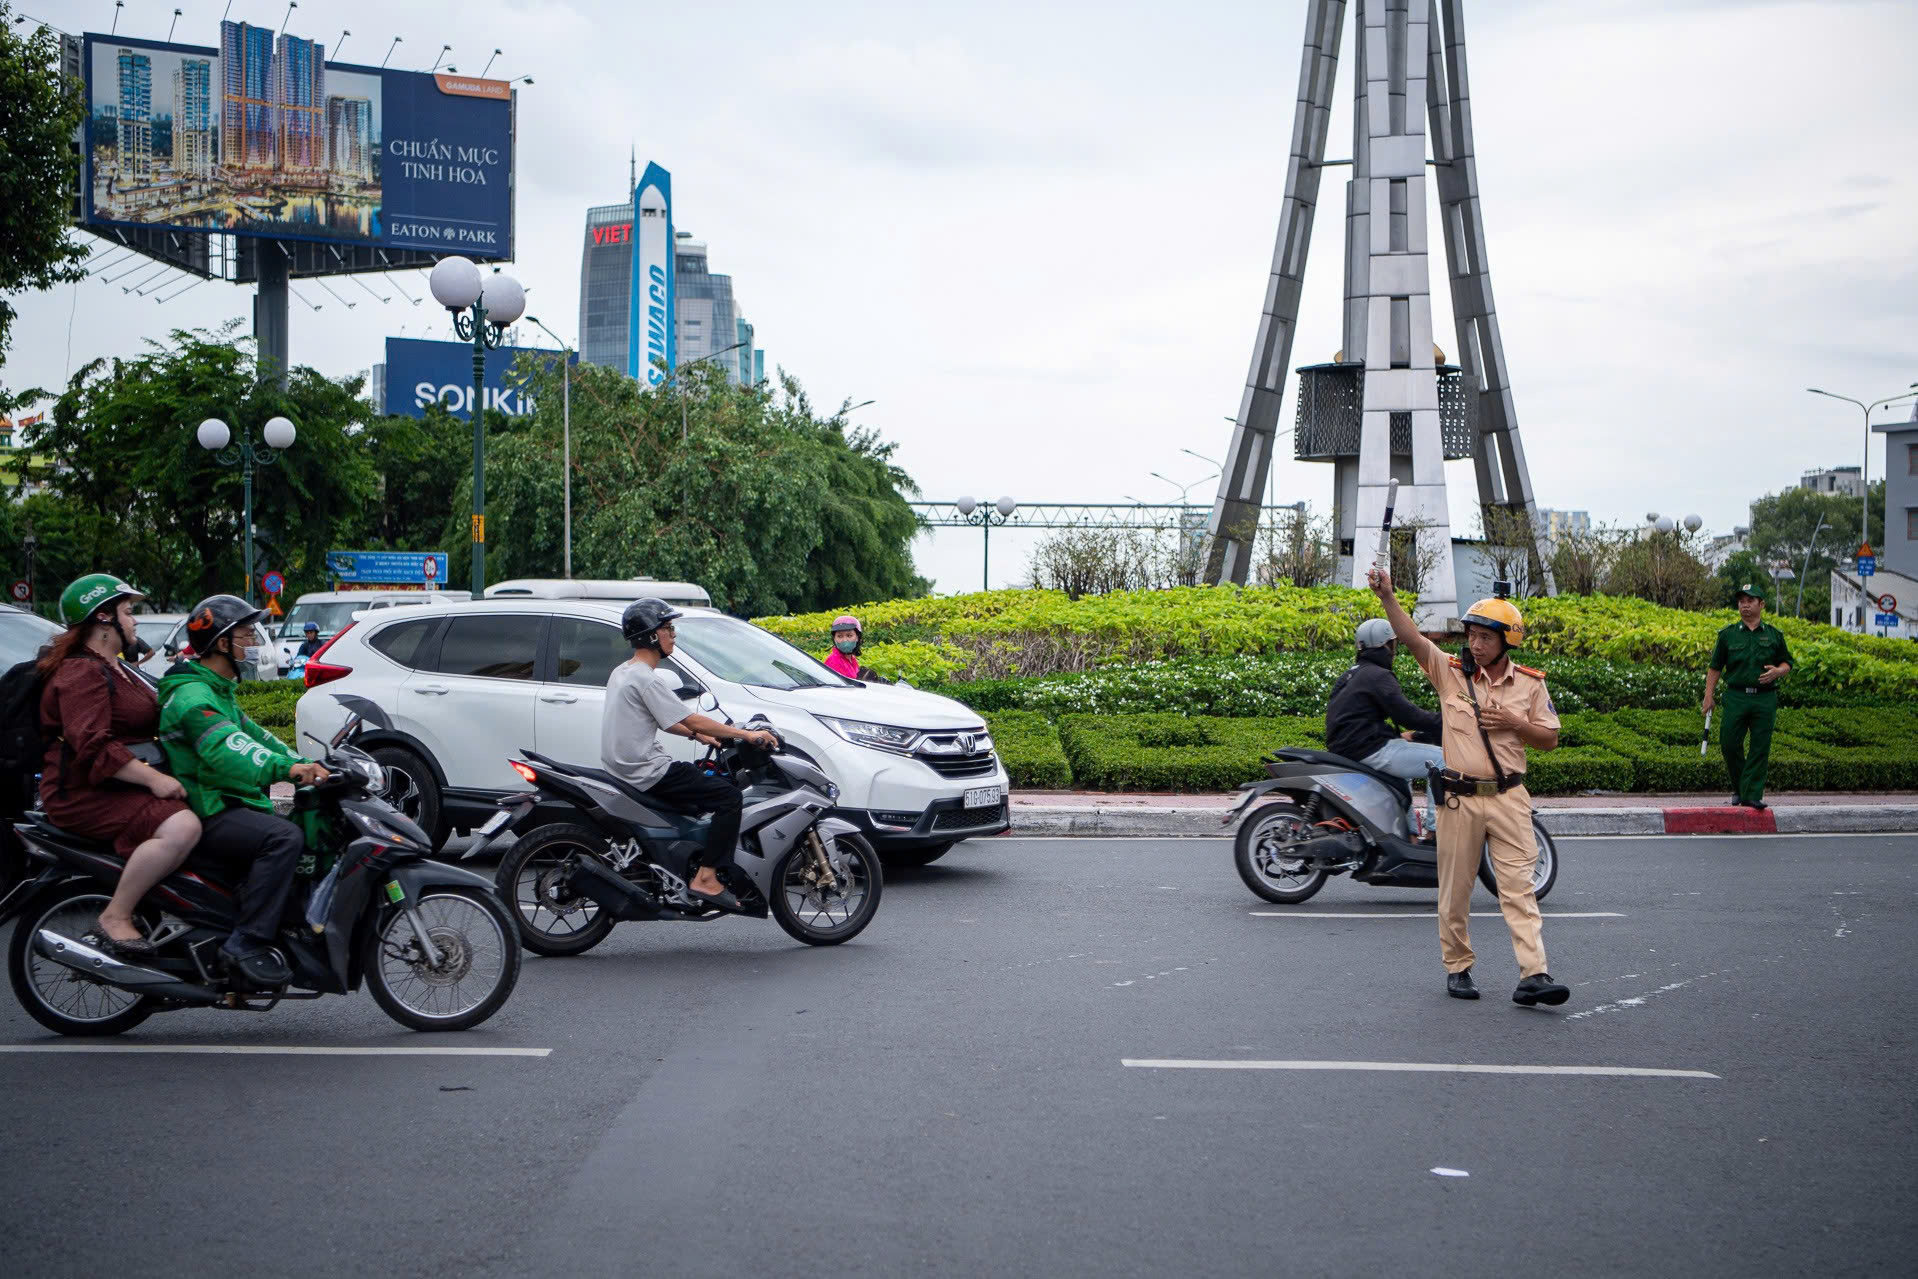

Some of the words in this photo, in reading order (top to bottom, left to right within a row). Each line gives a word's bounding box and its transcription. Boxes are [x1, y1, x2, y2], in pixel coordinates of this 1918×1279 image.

[445, 81, 481, 93] GAMUDA
[482, 85, 505, 95] LAND
[389, 138, 453, 160] CHUẨN
[457, 146, 499, 166] MỰC
[401, 161, 442, 181] TINH
[448, 166, 487, 185] HOA
[391, 223, 440, 239] EATON
[458, 228, 497, 244] PARK
[592, 223, 632, 245] VIET
[79, 585, 108, 604] Grab
[965, 787, 1000, 807] 51G-075.93
